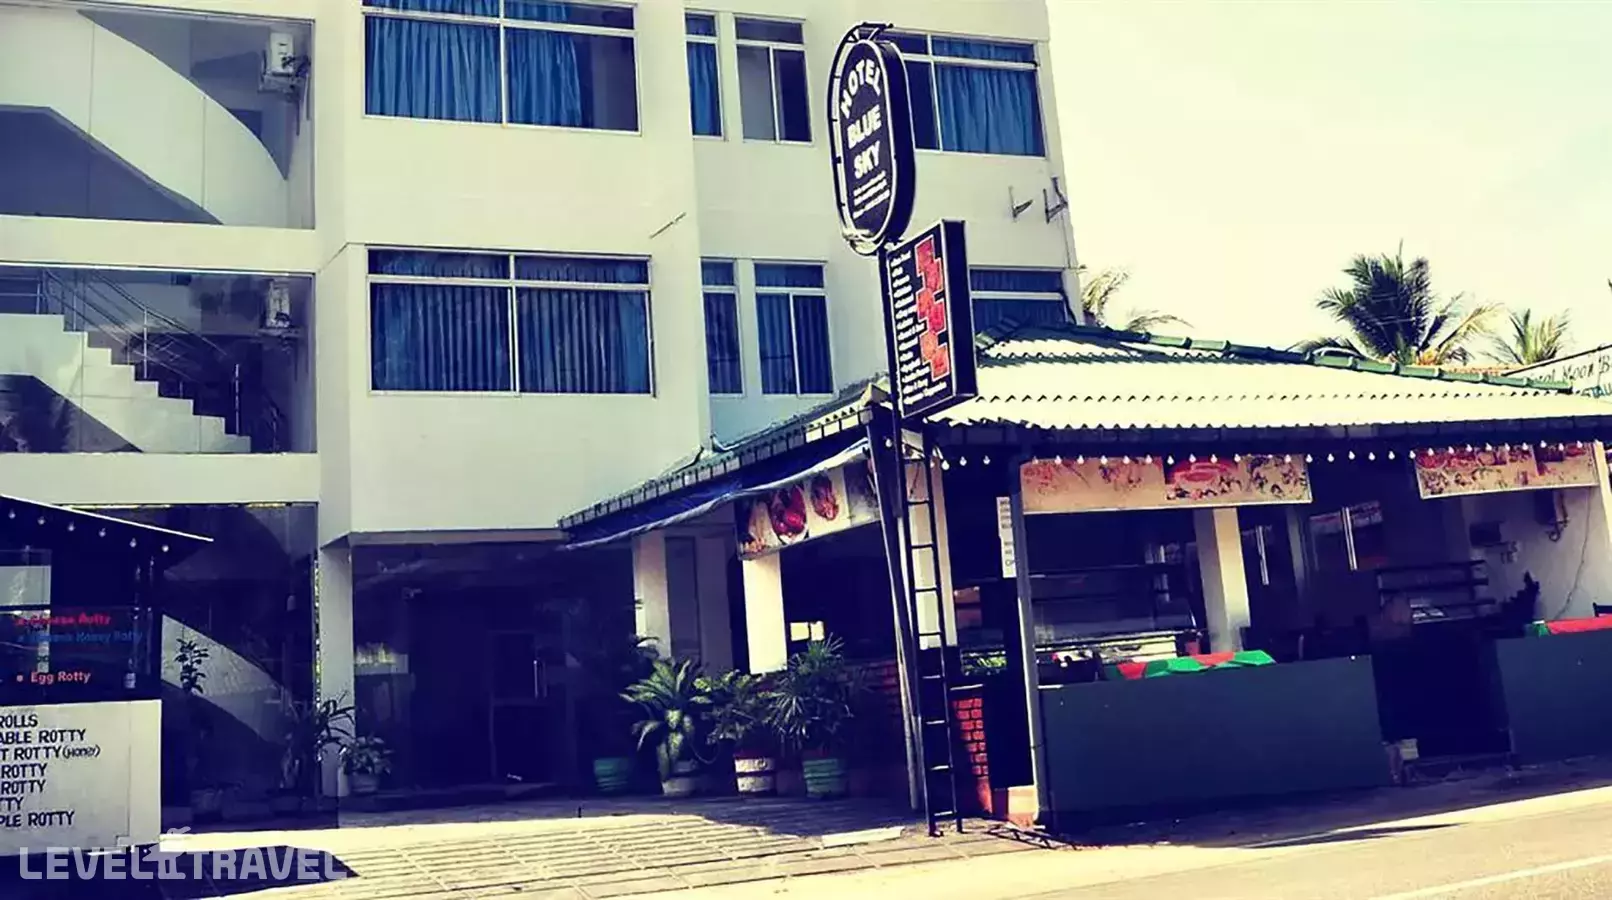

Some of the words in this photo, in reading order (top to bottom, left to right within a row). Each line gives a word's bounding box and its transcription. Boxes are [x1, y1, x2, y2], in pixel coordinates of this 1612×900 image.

[840, 59, 881, 119] HOTEL
[846, 104, 882, 149] BLUE
[854, 140, 881, 179] SKY
[30, 671, 54, 685] Egg
[57, 670, 92, 684] Rotty
[38, 729, 86, 744] ROTTY
[14, 746, 62, 761] ROTTY
[1, 763, 48, 779] ROTTY
[1, 780, 46, 795] ROTTY
[28, 811, 75, 827] ROTTY
